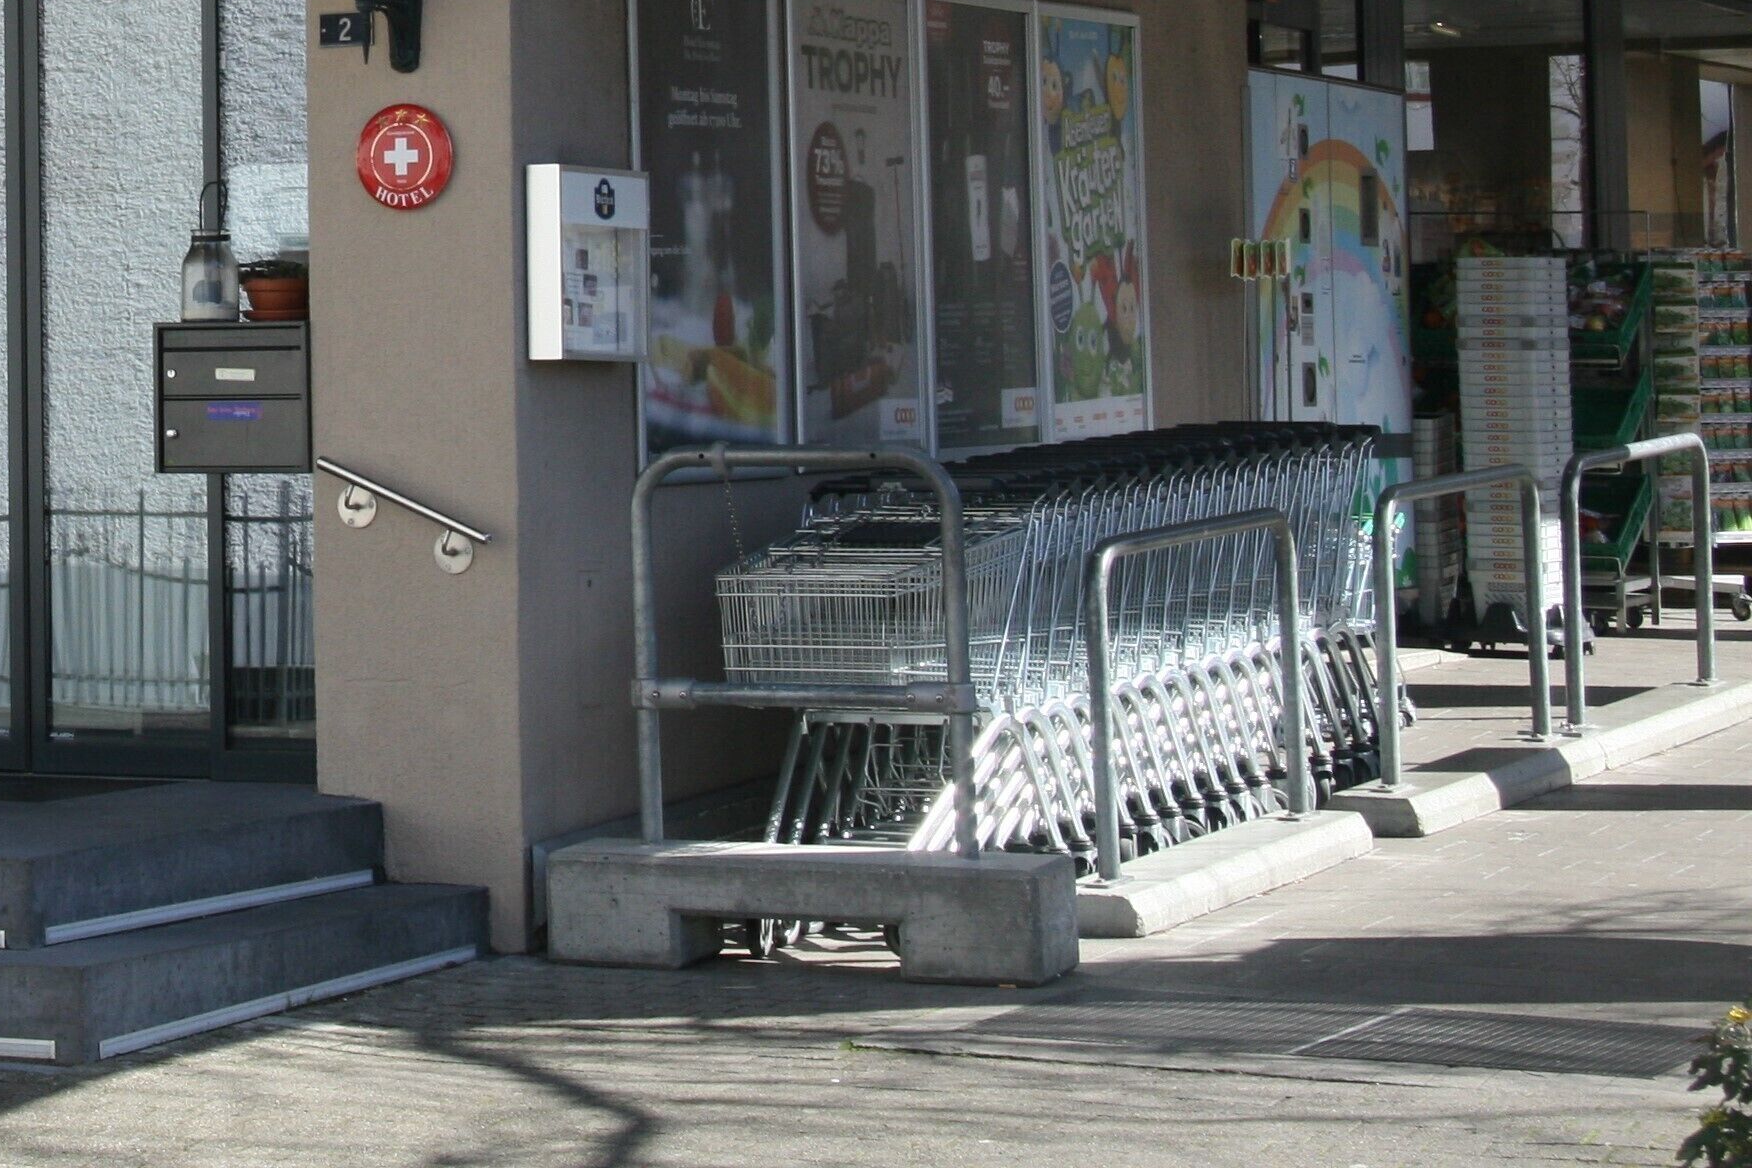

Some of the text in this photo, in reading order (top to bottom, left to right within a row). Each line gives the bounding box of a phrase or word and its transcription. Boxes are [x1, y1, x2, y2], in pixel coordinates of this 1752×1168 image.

[338, 17, 352, 41] 2
[800, 45, 902, 99] TROPHY
[375, 185, 434, 208] HOTEL
